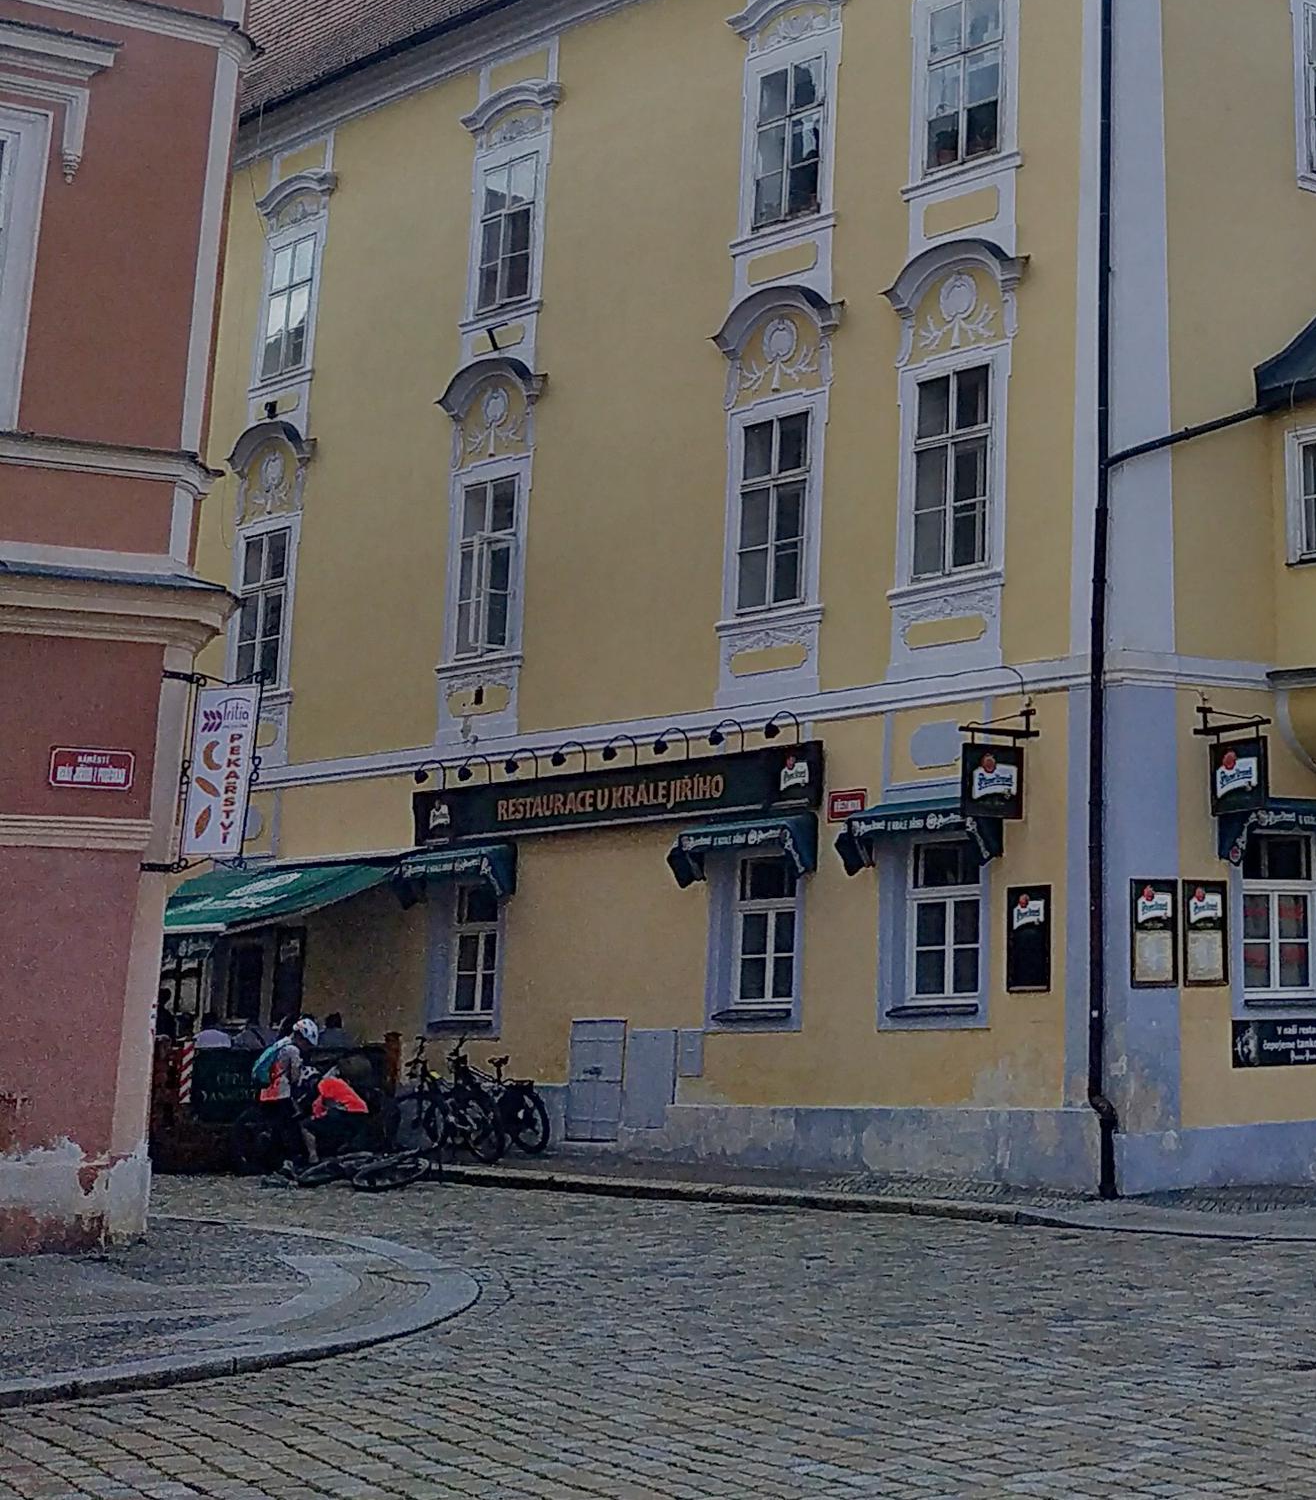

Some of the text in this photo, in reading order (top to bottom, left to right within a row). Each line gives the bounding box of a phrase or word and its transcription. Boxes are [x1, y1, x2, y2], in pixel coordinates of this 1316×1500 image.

[216, 697, 250, 721] Tritia
[220, 733, 243, 844] PEKAŘSTVÍ
[497, 773, 724, 821] RESTAURACE U KRÁLE JIŘÍHO
